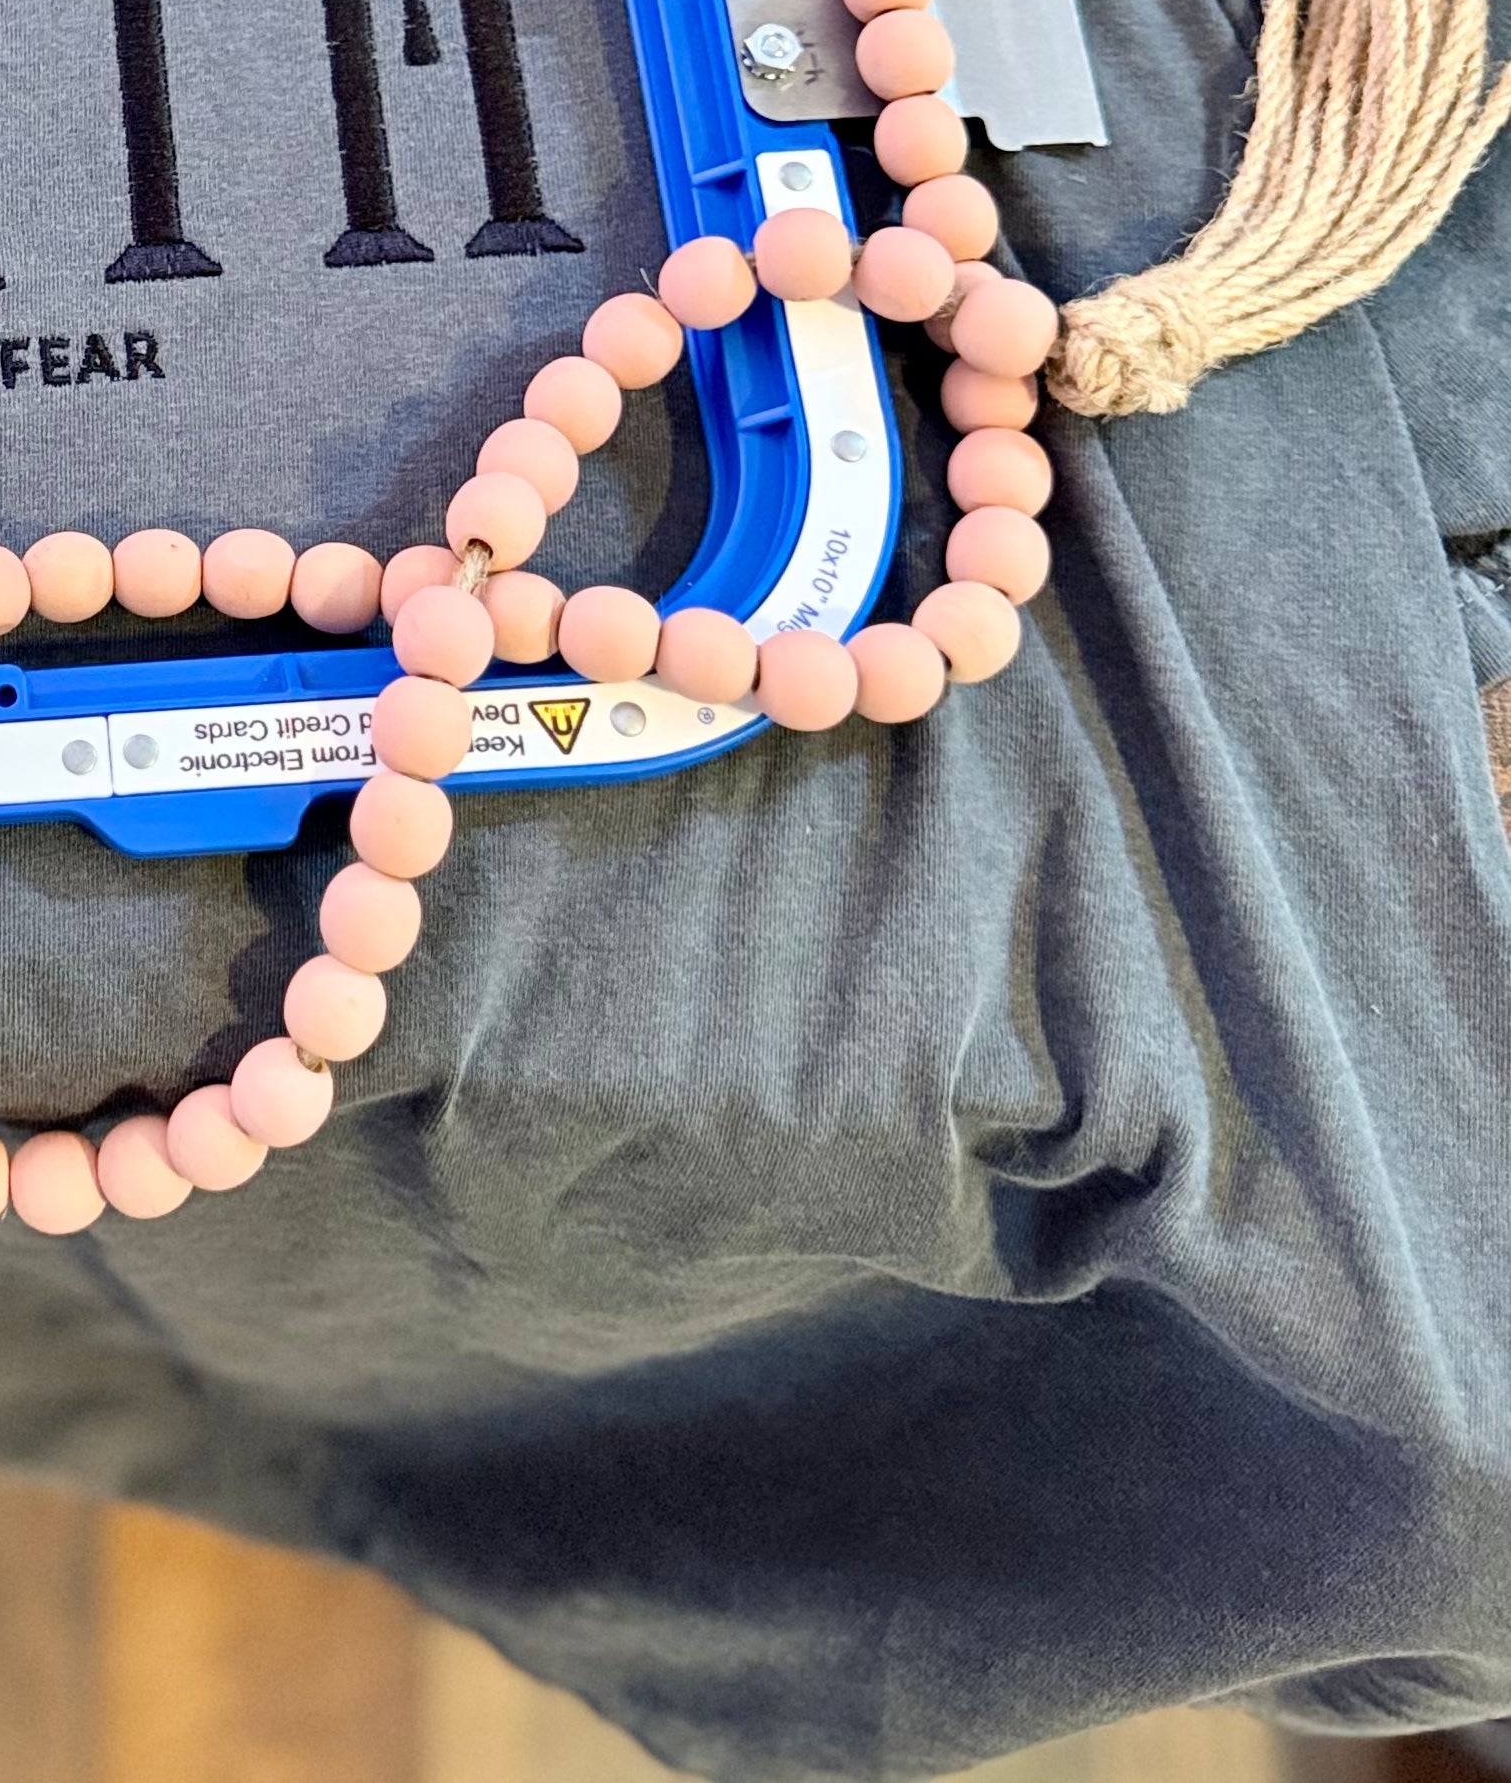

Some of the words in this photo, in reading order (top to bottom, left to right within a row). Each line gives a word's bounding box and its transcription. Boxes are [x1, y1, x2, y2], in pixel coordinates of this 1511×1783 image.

[0, 320, 166, 390] FEAR
[194, 719, 269, 744] Cards
[275, 714, 351, 740] Credit
[312, 743, 377, 766] From
[466, 734, 526, 757] Kee
[179, 748, 305, 778] Electronic
